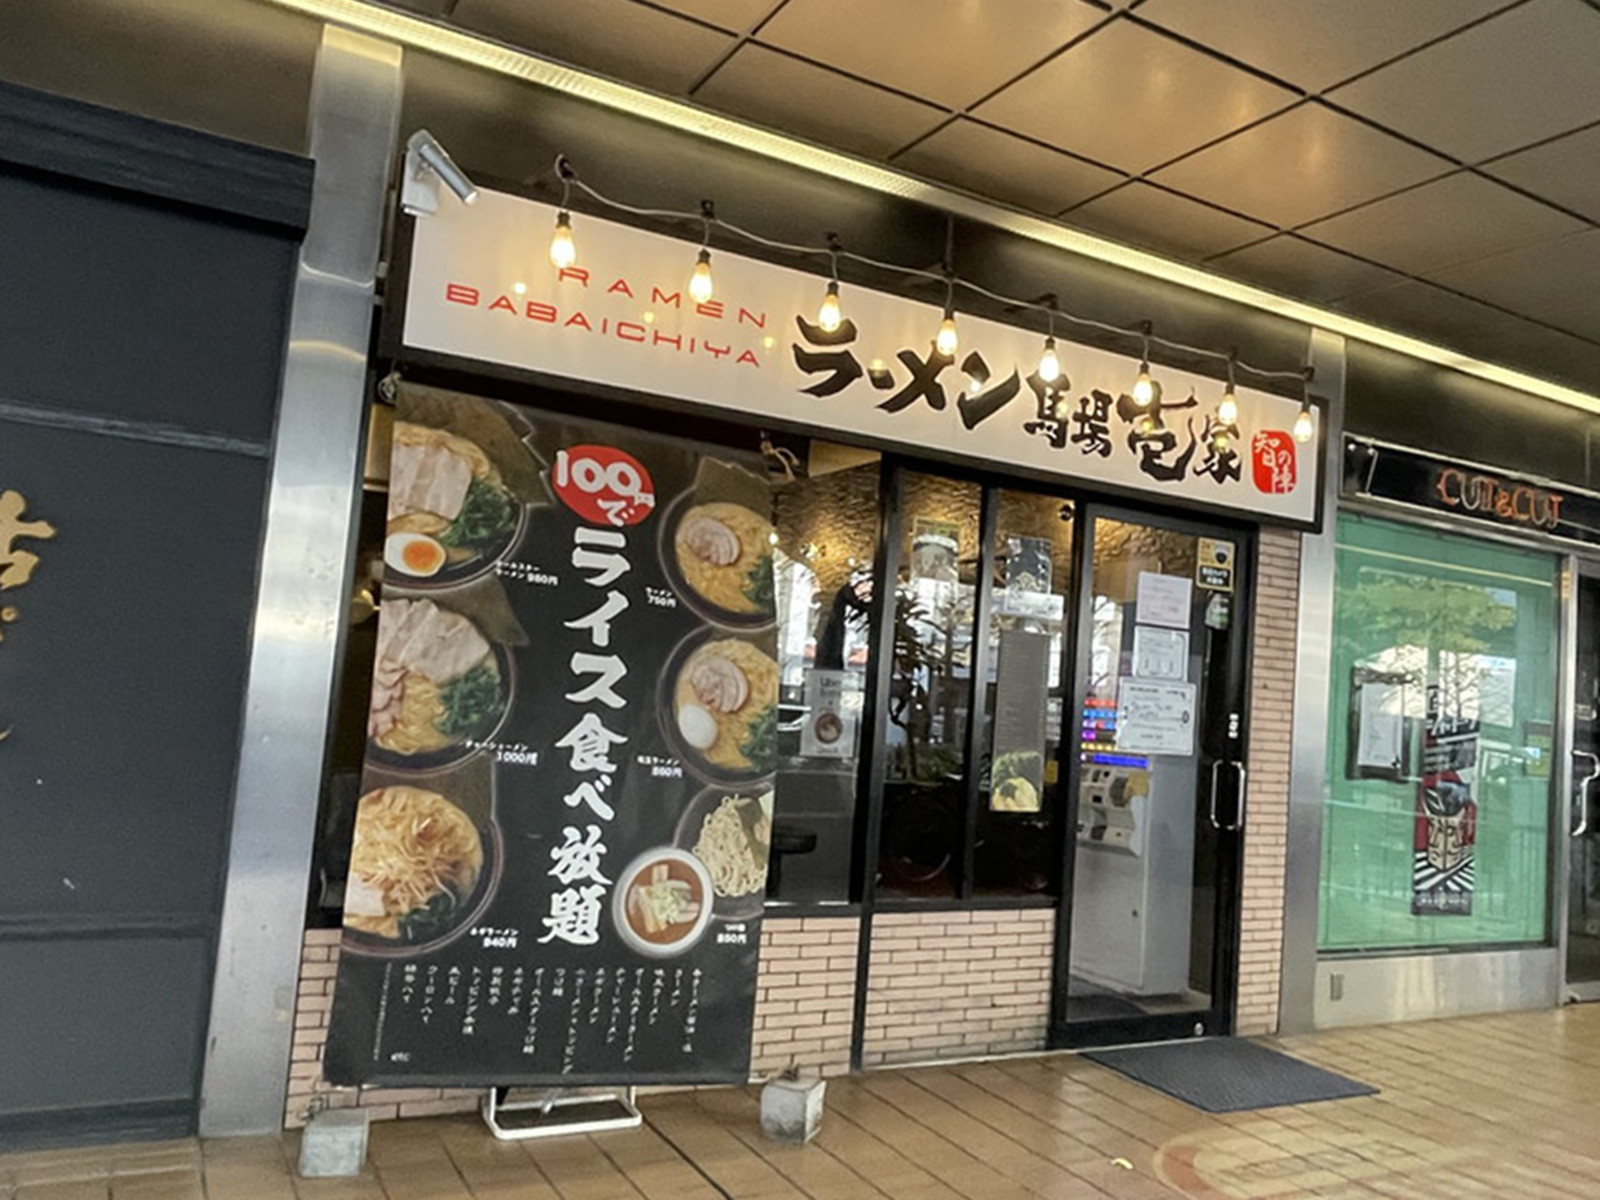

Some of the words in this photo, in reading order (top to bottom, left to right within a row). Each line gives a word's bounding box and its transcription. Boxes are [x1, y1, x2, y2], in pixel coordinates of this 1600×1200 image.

[446, 283, 760, 368] BABAICHIYA
[558, 267, 767, 329] RAMEN
[537, 526, 632, 945] ライス食べ放題
